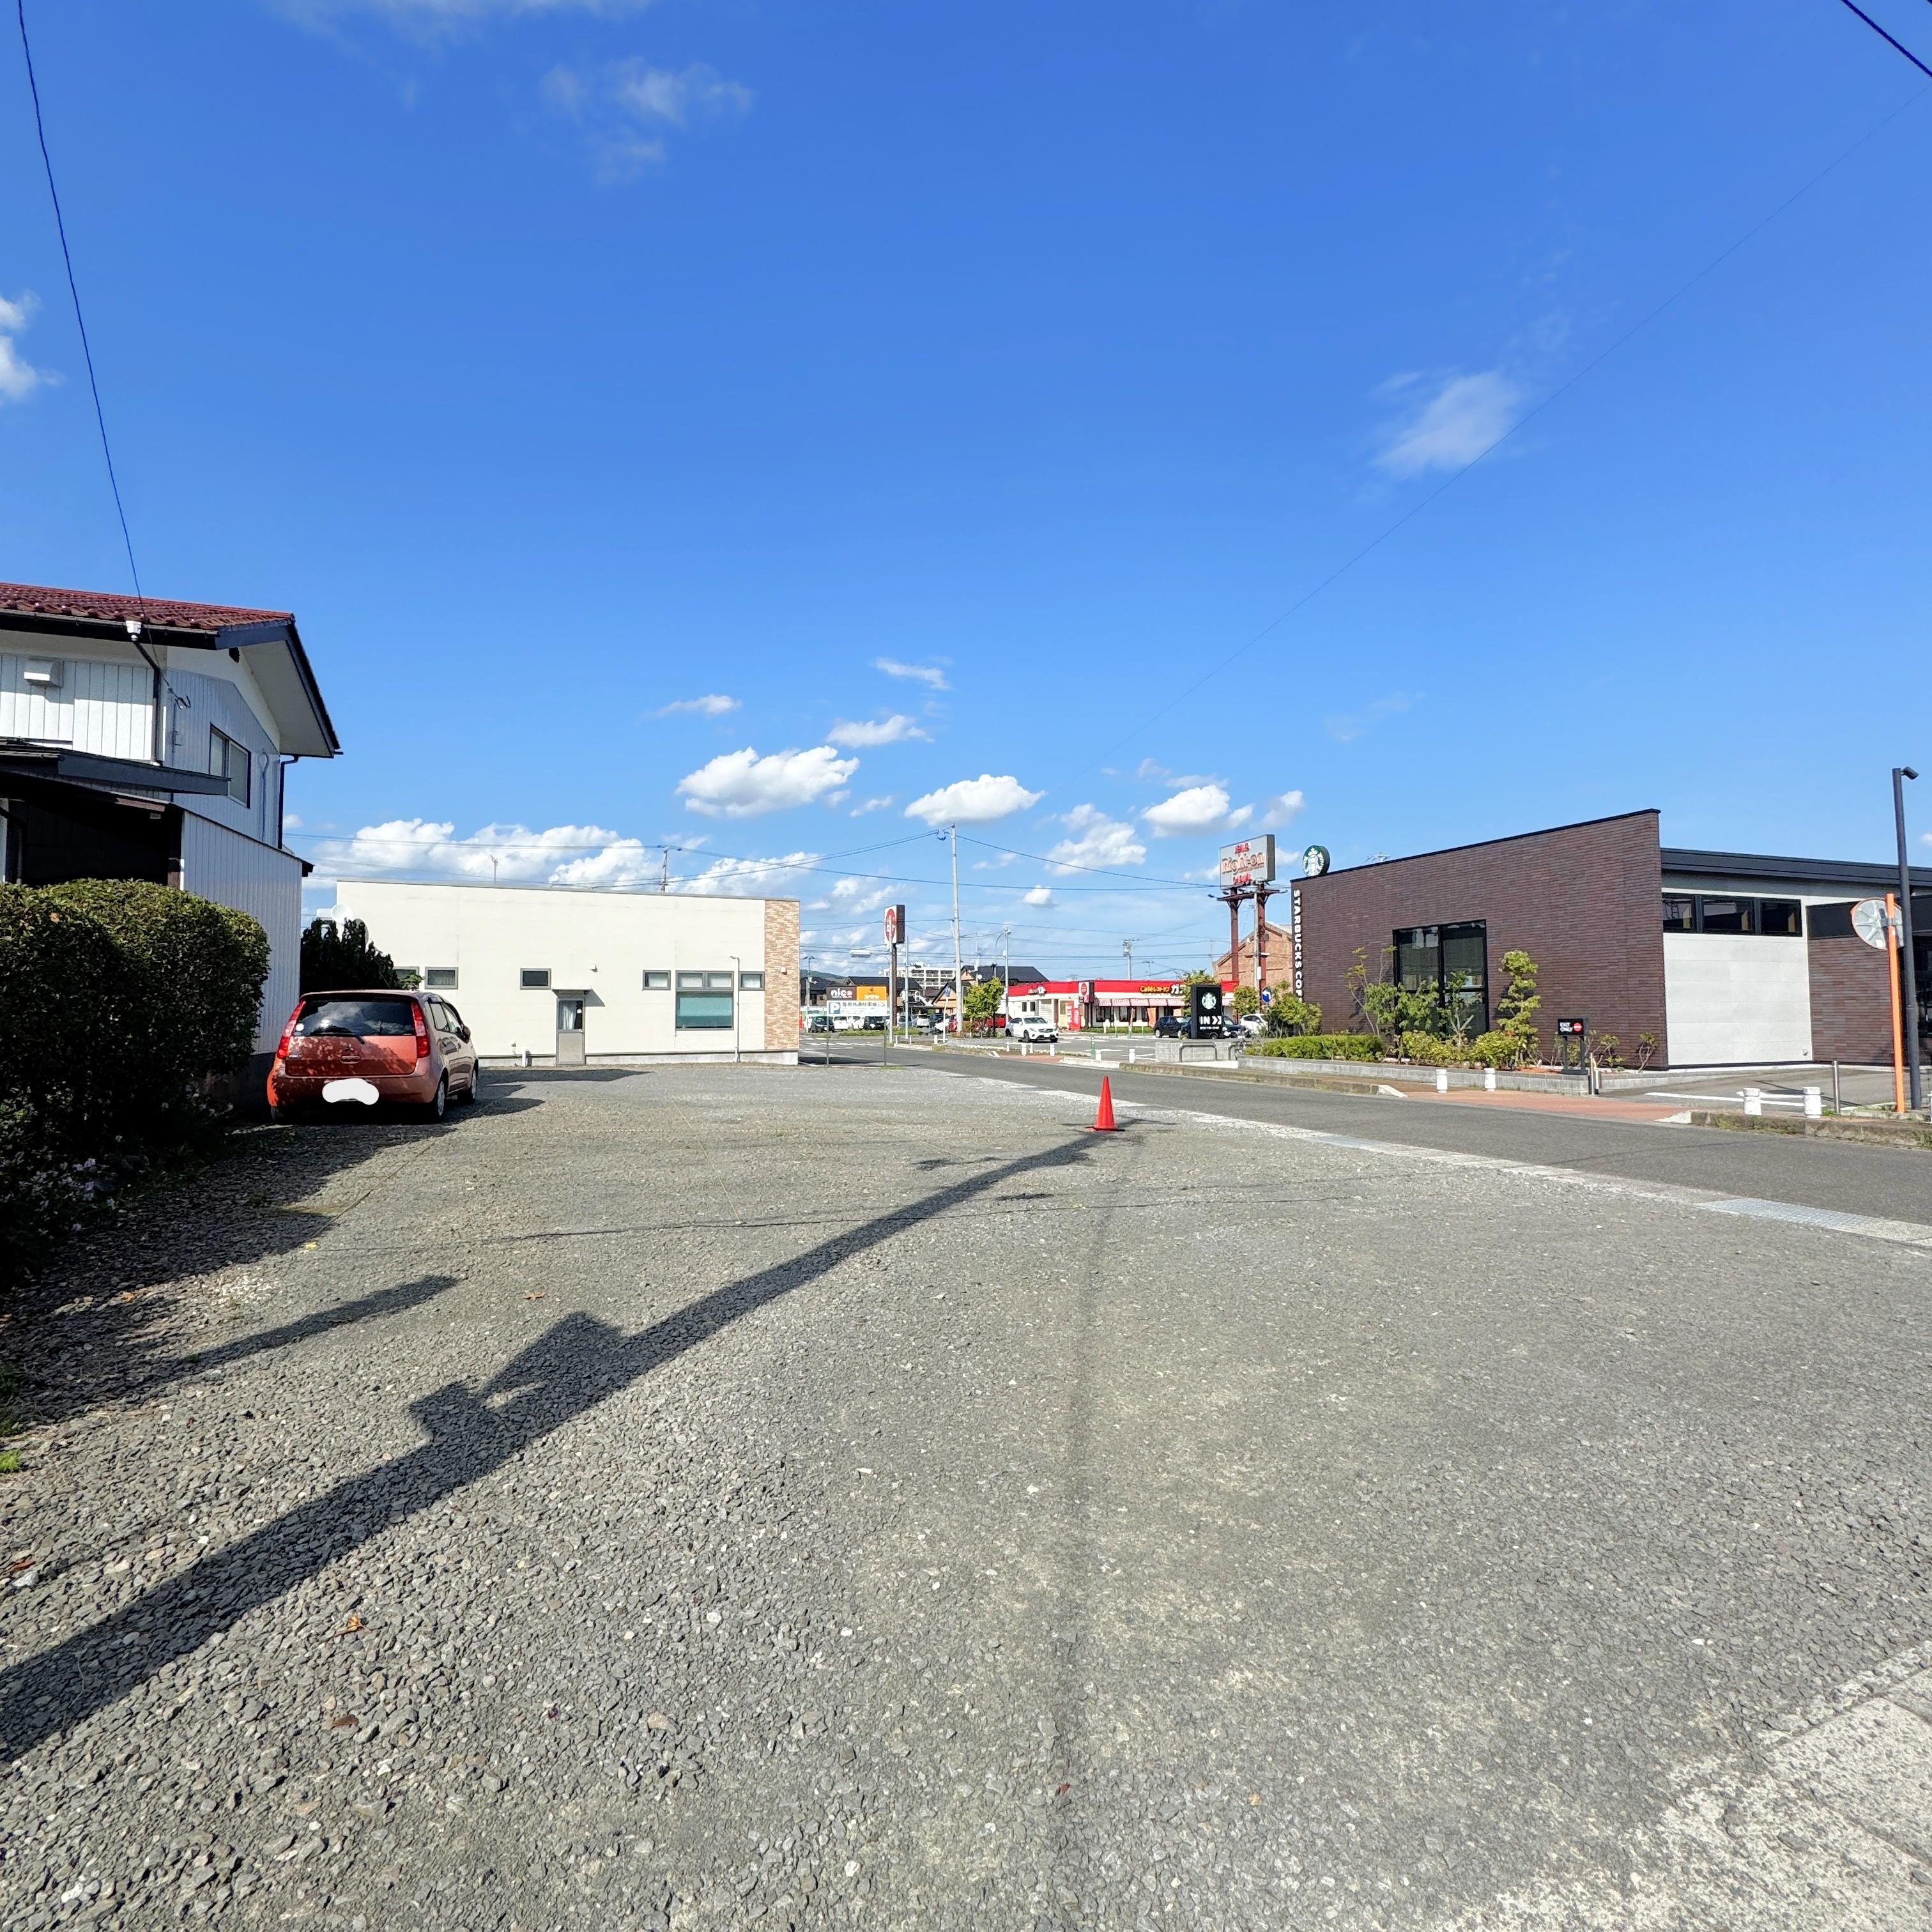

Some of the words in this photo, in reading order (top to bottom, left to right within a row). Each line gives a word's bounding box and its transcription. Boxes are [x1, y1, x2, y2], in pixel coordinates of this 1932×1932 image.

[1293, 889, 1302, 969] STARBUCKS
[830, 1002, 840, 1014] P
[1200, 1016, 1210, 1025] IN
